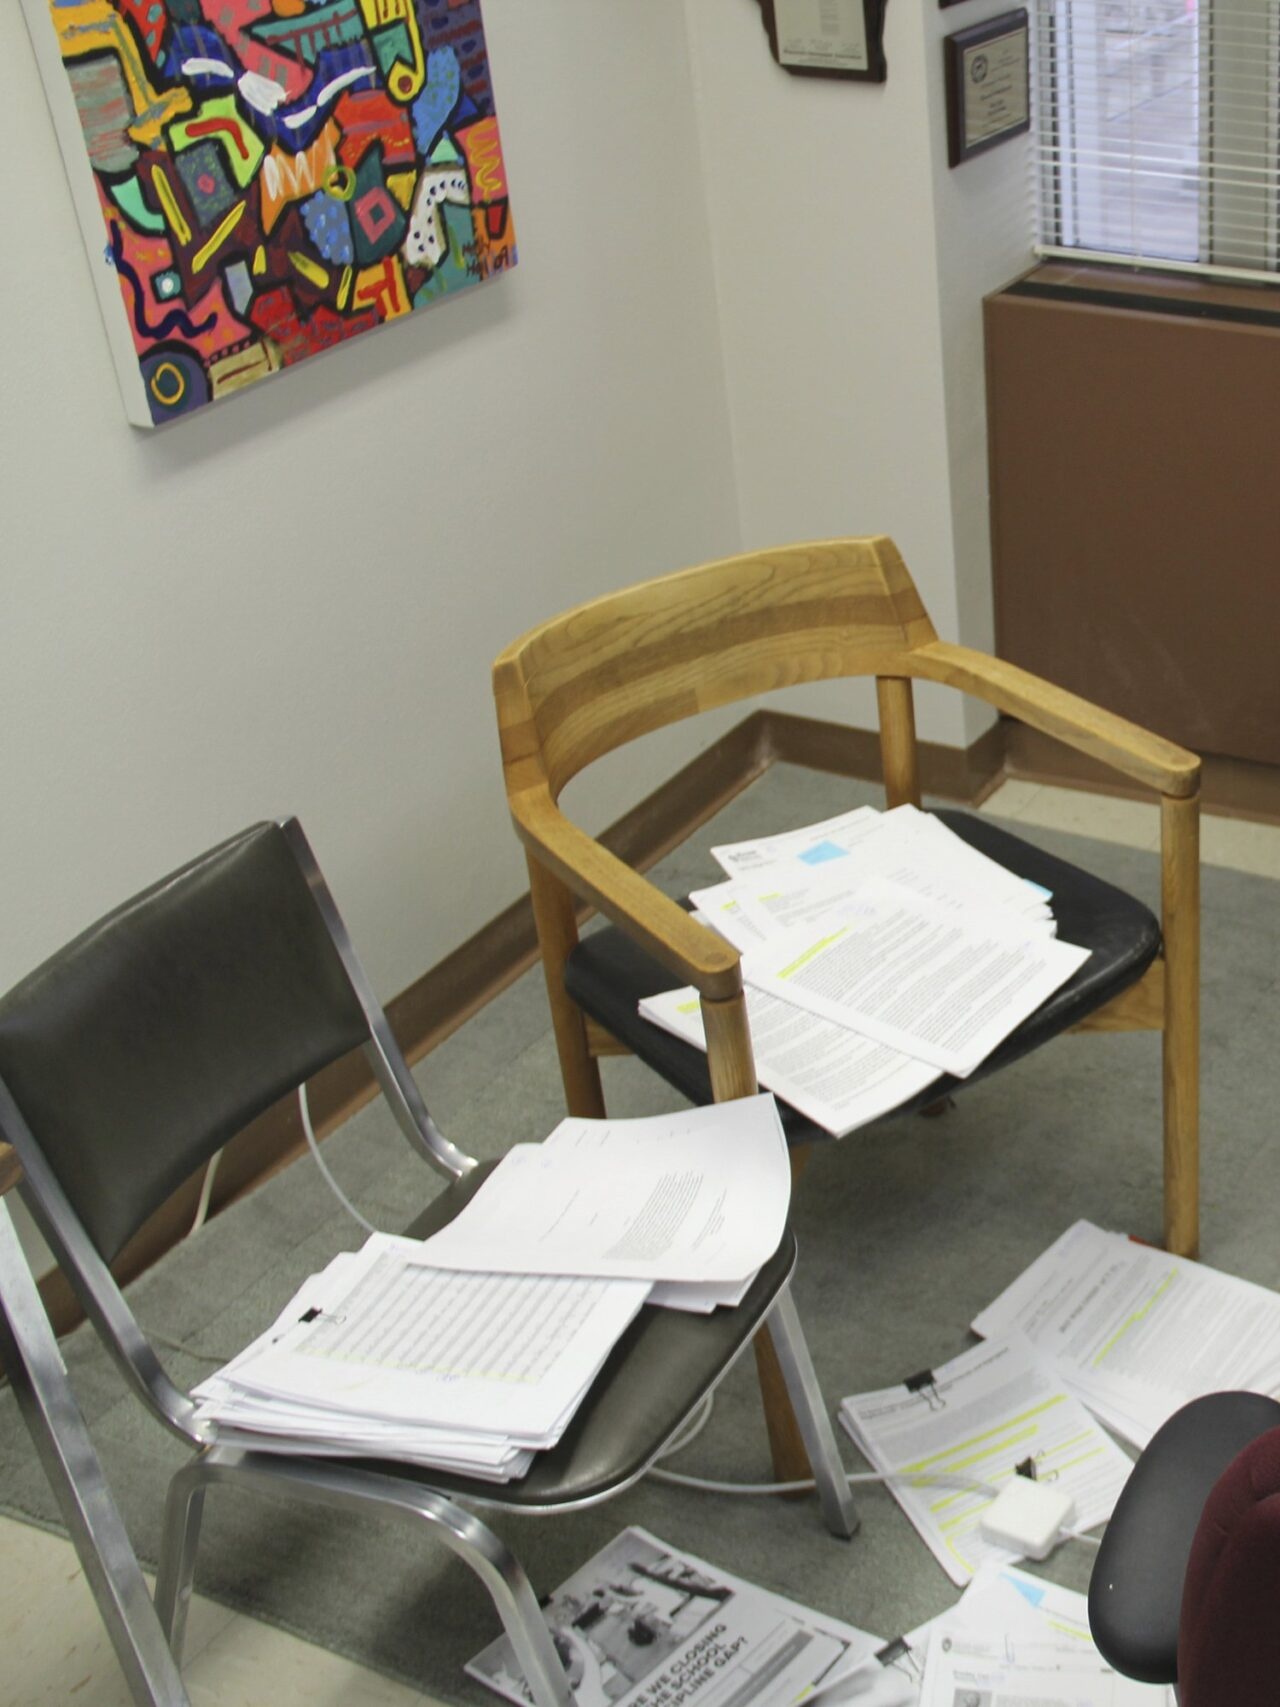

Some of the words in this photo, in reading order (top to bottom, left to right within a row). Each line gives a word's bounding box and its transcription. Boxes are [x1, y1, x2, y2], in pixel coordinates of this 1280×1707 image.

[646, 1674, 671, 1695] WE
[670, 1624, 727, 1675] CLOSING
[670, 1643, 727, 1690] SCHOOL
[714, 1635, 749, 1668] GAP?
